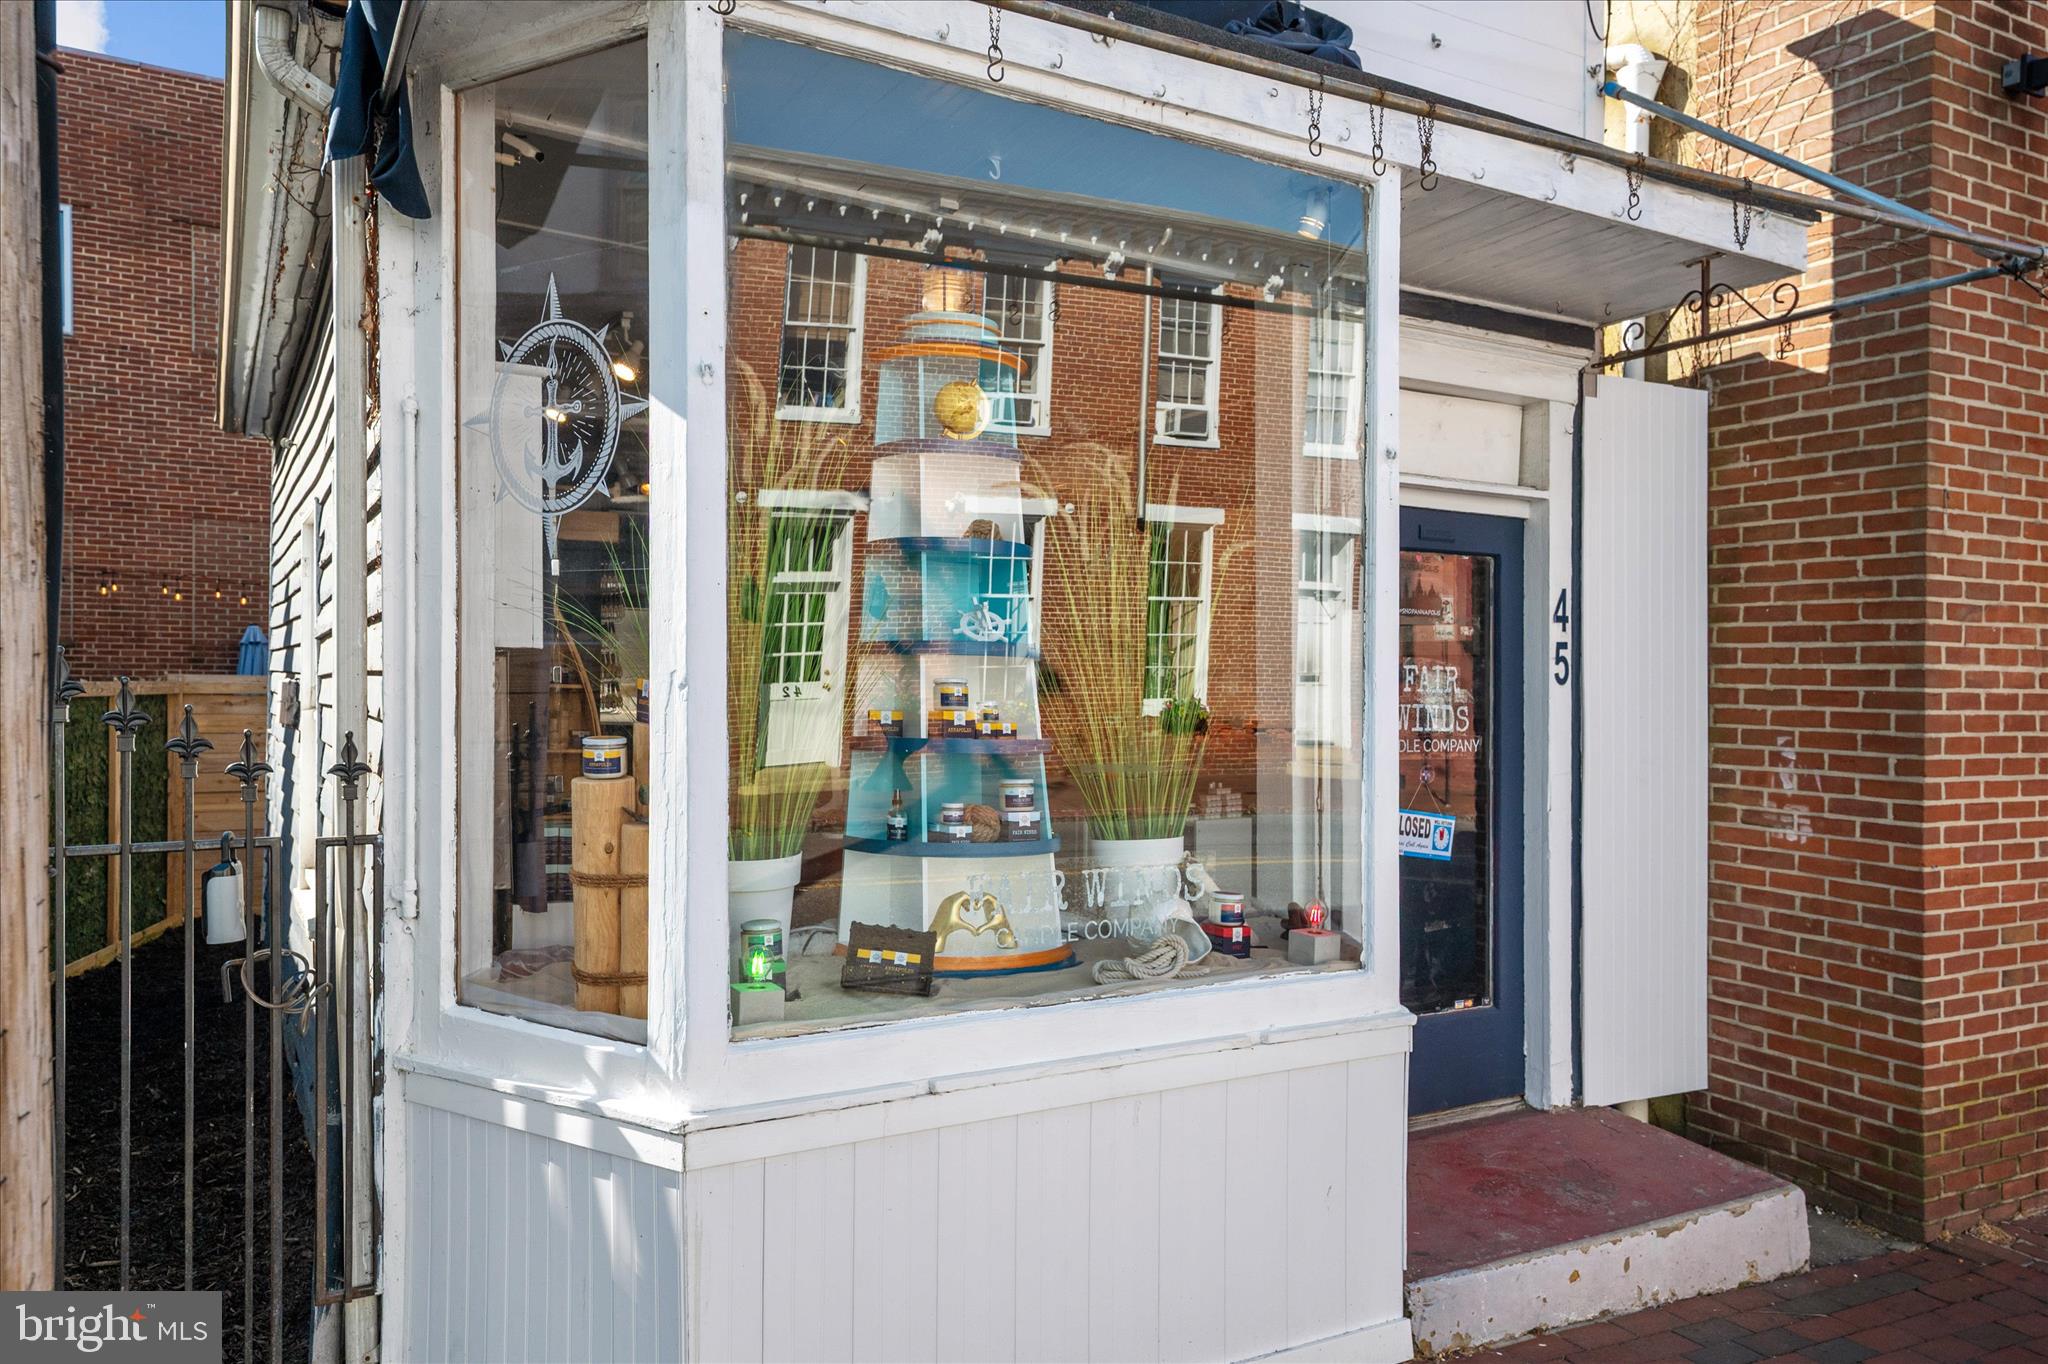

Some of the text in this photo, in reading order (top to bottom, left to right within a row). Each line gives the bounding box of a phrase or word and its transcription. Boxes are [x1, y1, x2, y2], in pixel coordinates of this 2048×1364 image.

[1403, 664, 1459, 693] FAIR
[1399, 703, 1470, 733] WINDS
[1423, 739, 1481, 753] COMPANY
[1399, 815, 1432, 839] LOSED
[967, 863, 1206, 916] FAIR WINDS
[996, 917, 1179, 949] CDLE COMPANY
